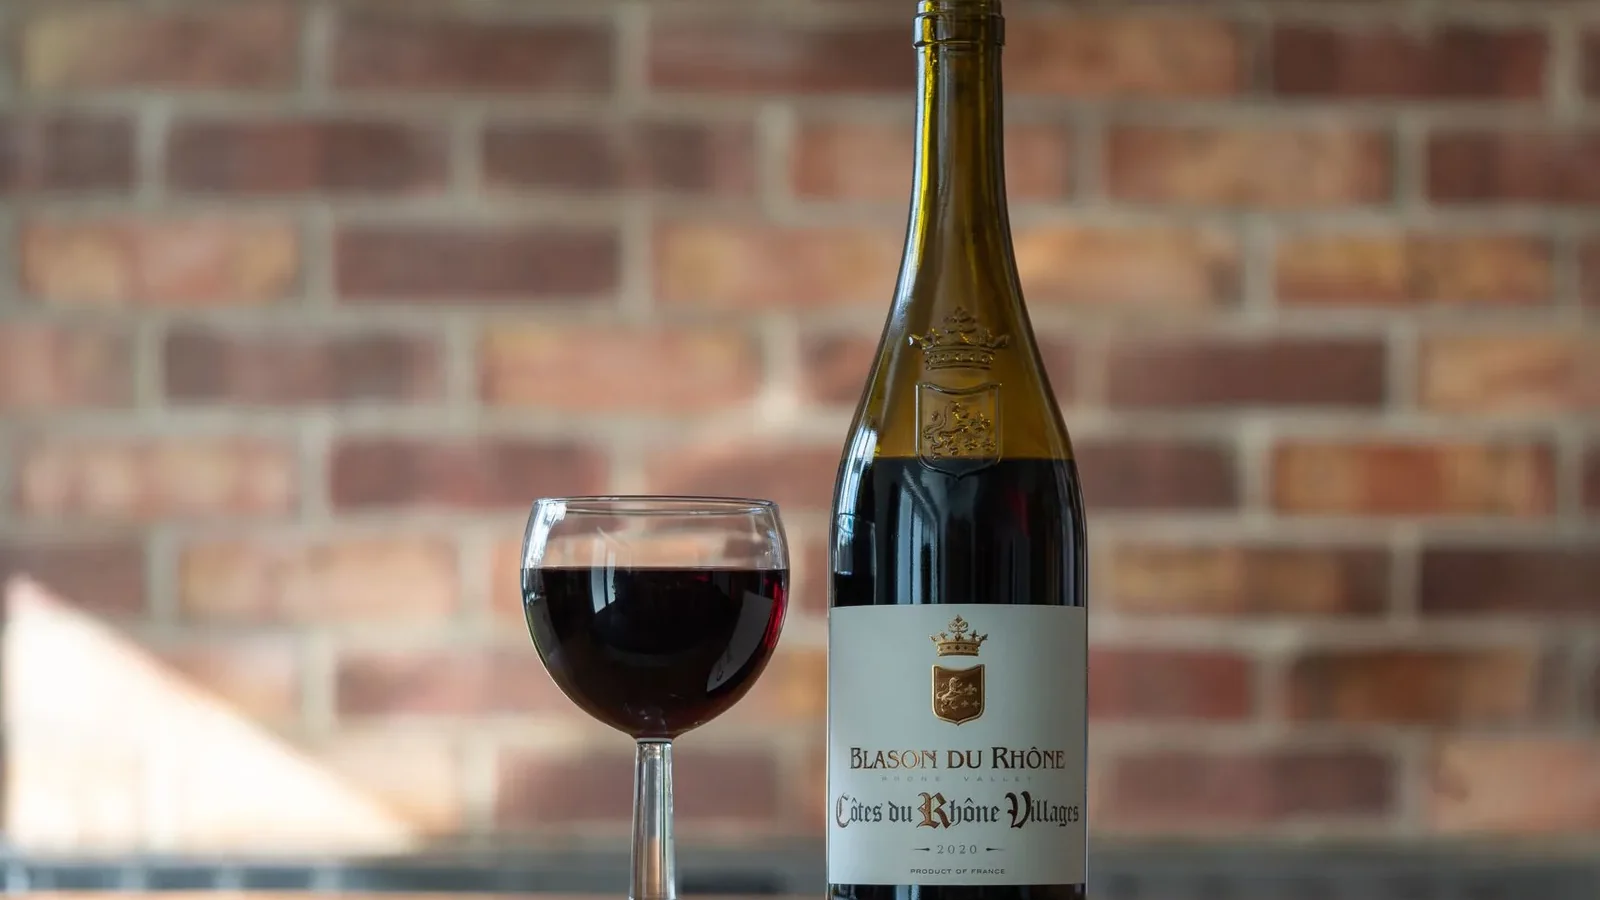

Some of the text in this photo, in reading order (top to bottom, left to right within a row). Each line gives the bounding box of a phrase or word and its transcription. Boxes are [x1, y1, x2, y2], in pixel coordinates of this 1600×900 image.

[850, 746, 1065, 769] BLASON DU RHÔNE
[835, 790, 1079, 829] Côtes du Rhône Villages
[937, 844, 978, 855] 2020
